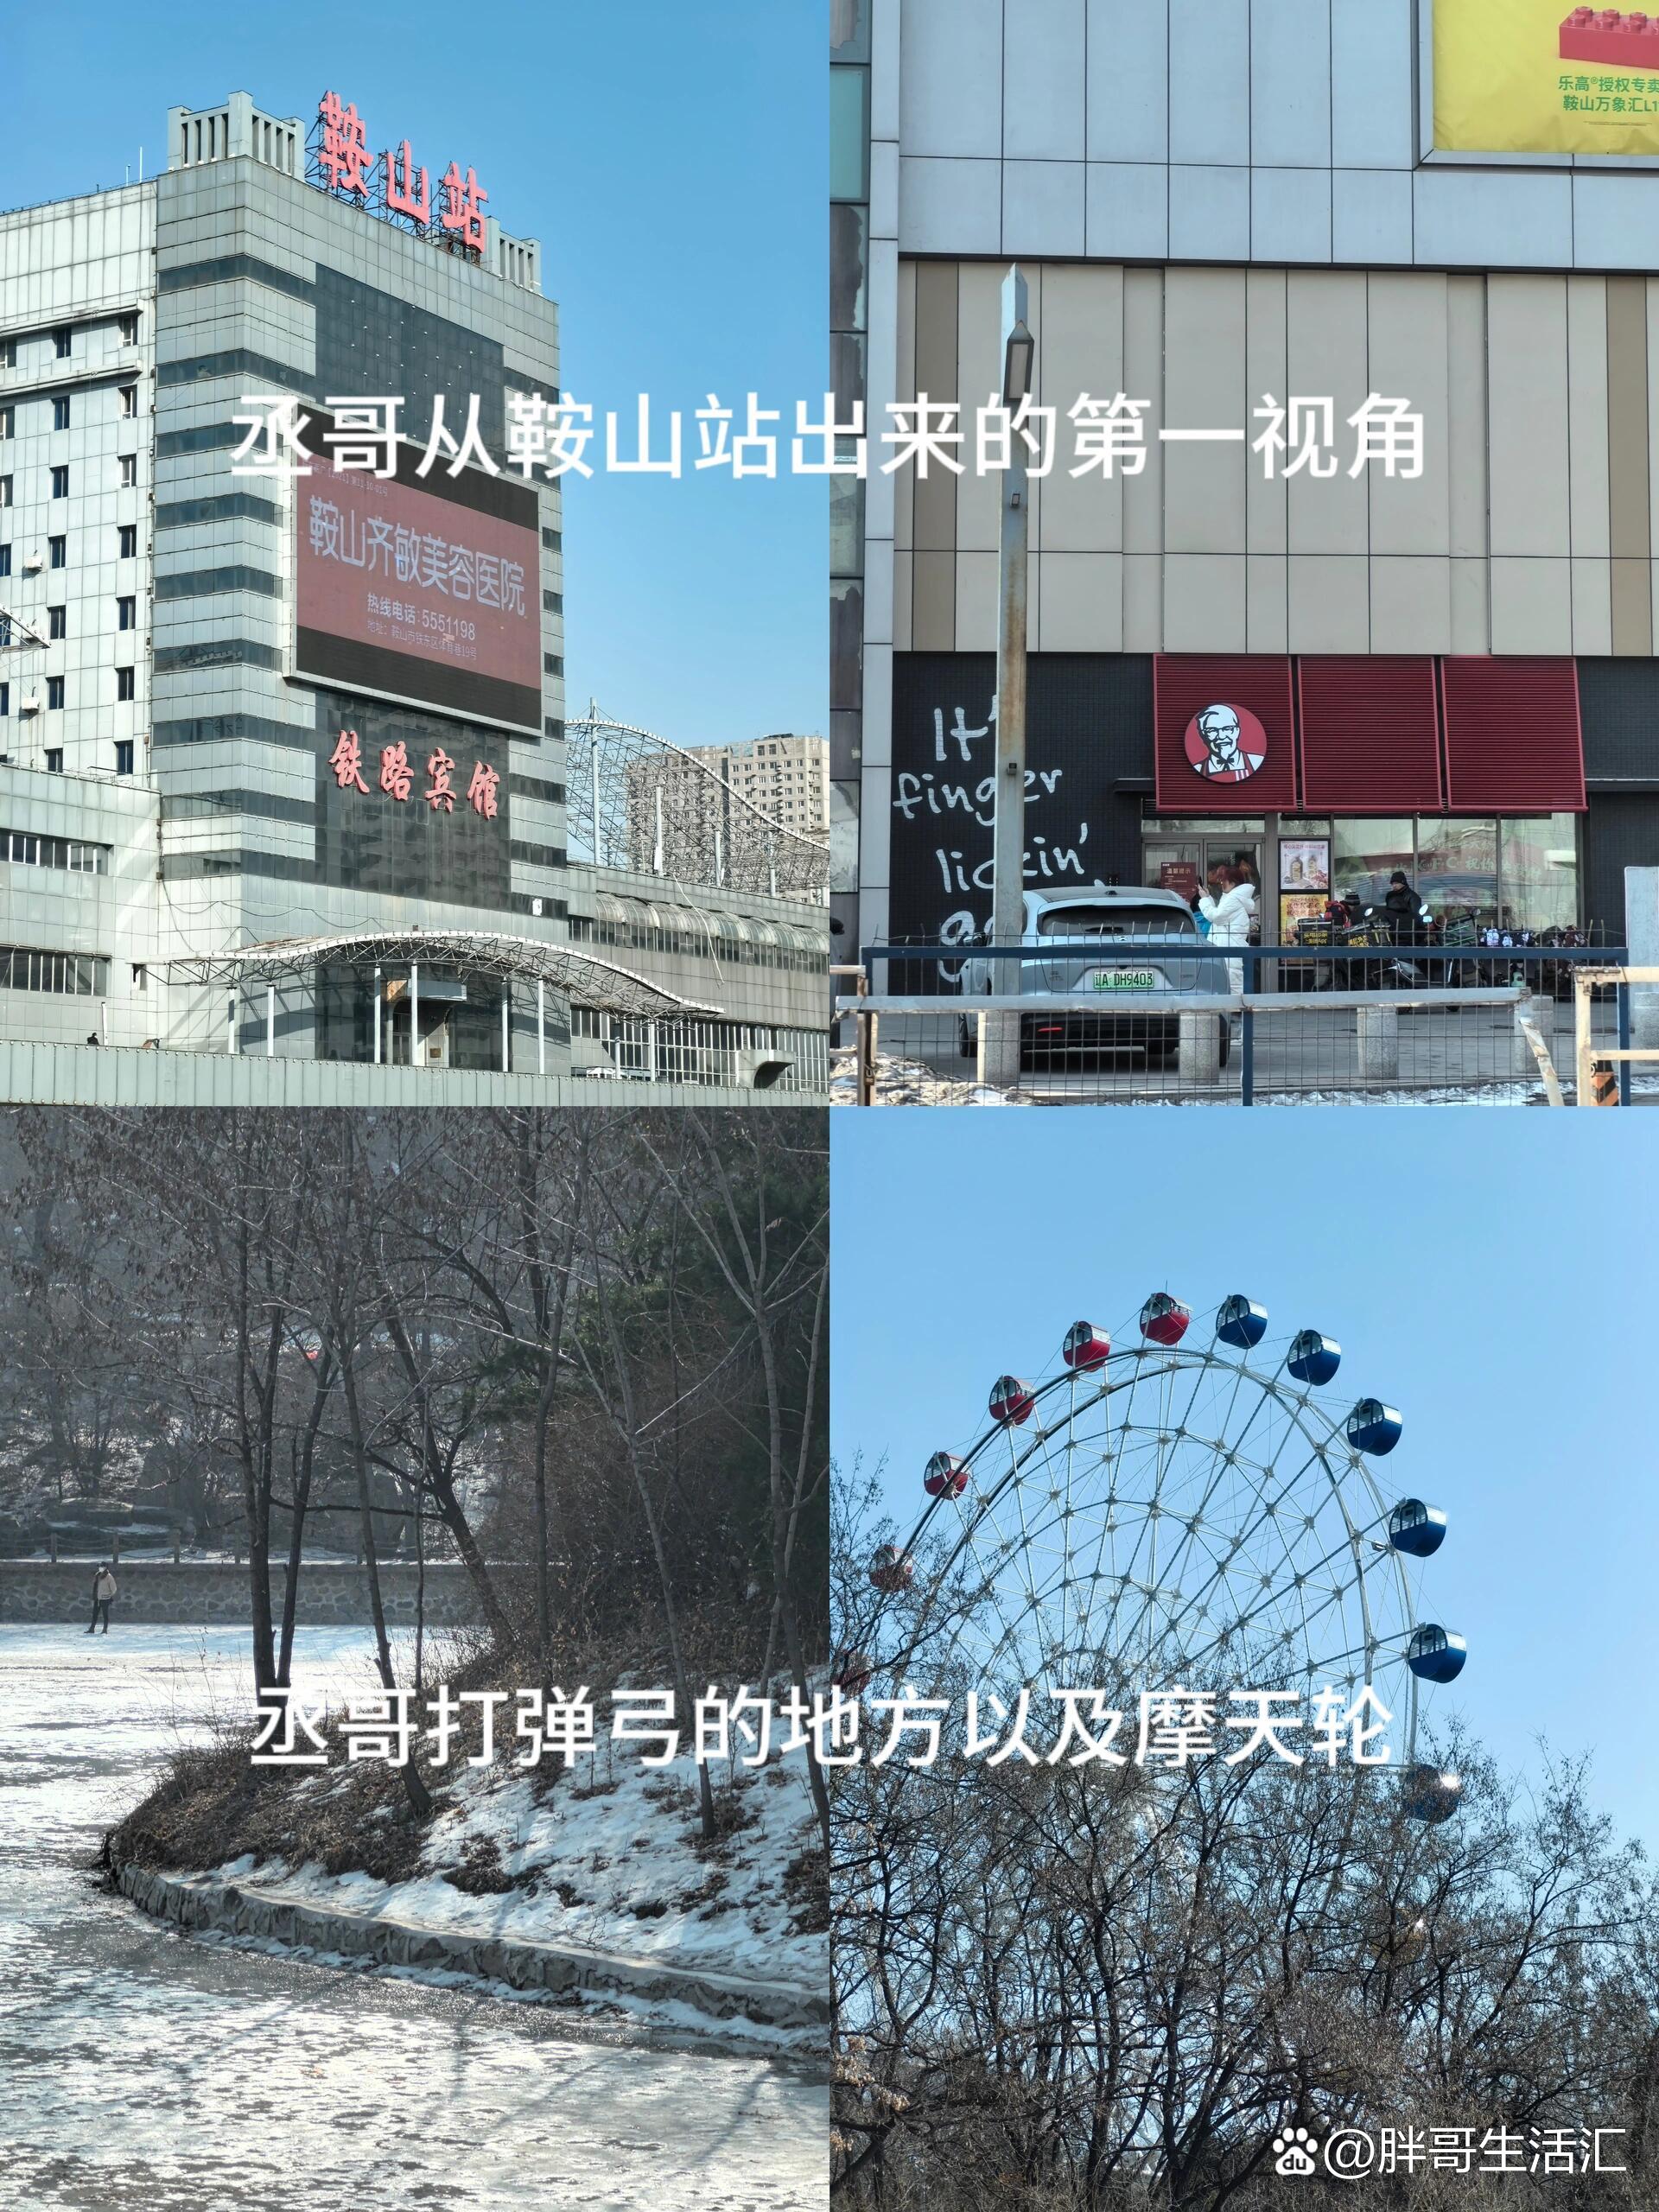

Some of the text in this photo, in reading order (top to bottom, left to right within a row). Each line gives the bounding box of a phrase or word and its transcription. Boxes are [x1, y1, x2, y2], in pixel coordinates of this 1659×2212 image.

[1562, 94, 1659, 113] 鞍山万象汇L1
[319, 90, 489, 254] 鞍山站
[309, 494, 525, 617] 鞍山齐敏美容医院
[327, 729, 500, 821] 铁路宾馆
